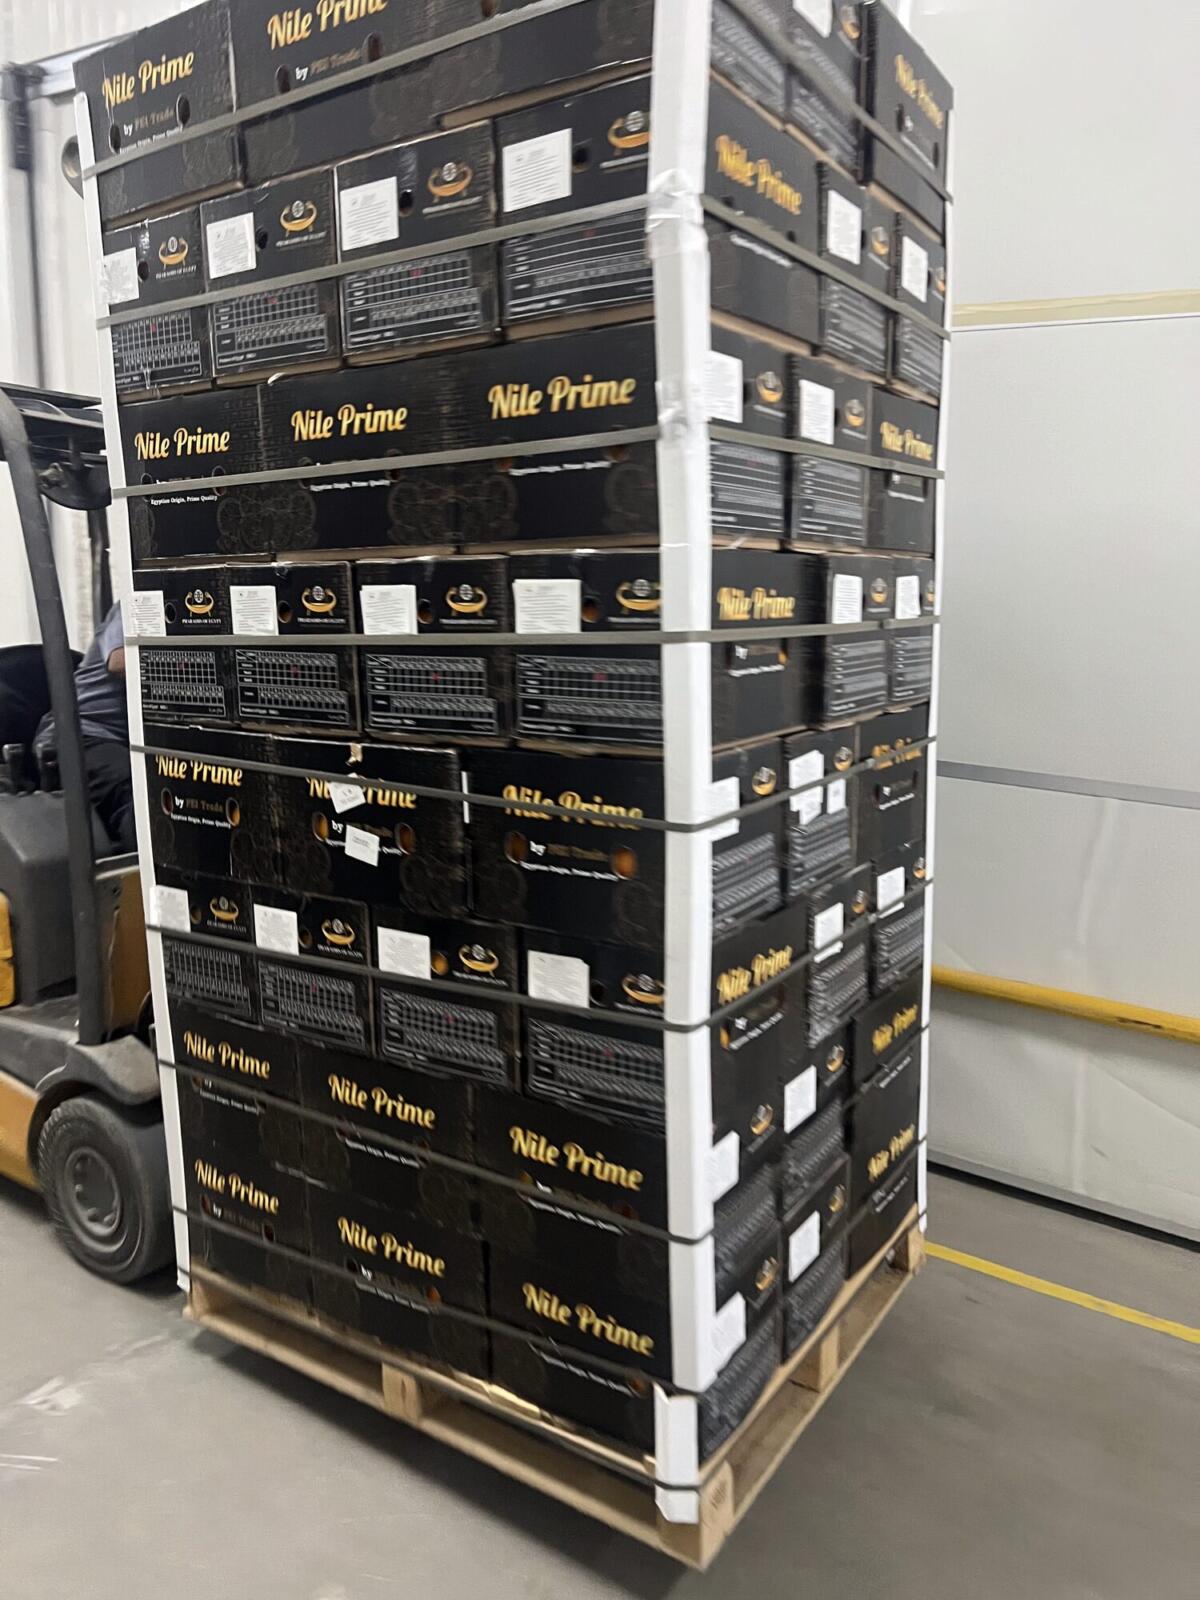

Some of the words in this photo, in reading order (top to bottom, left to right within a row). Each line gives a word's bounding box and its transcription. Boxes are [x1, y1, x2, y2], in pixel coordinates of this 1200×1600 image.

[267, 8, 313, 50] Nile
[102, 69, 135, 108] Nile
[138, 51, 194, 94] Prime
[295, 66, 309, 81] by
[488, 383, 543, 420] Nile
[547, 374, 636, 412] Prime
[134, 431, 170, 460] Nile
[173, 427, 230, 456] Prime
[291, 410, 333, 441] Nile
[337, 402, 408, 436] Prime
[155, 753, 188, 779] Nile
[190, 760, 243, 787] Prime
[174, 795, 184, 809] by
[184, 1030, 215, 1063] Nile
[218, 1041, 270, 1080] Prime
[328, 1073, 368, 1109] Nile
[371, 1087, 436, 1130] Prime
[509, 1126, 560, 1167] Nile
[563, 1141, 644, 1192] Prime
[194, 1159, 225, 1194] Nile
[228, 1172, 279, 1216] Prime
[337, 1216, 378, 1255] Nile
[381, 1232, 446, 1278] Prime
[522, 1282, 572, 1326] Nile
[575, 1303, 655, 1357] Prime
